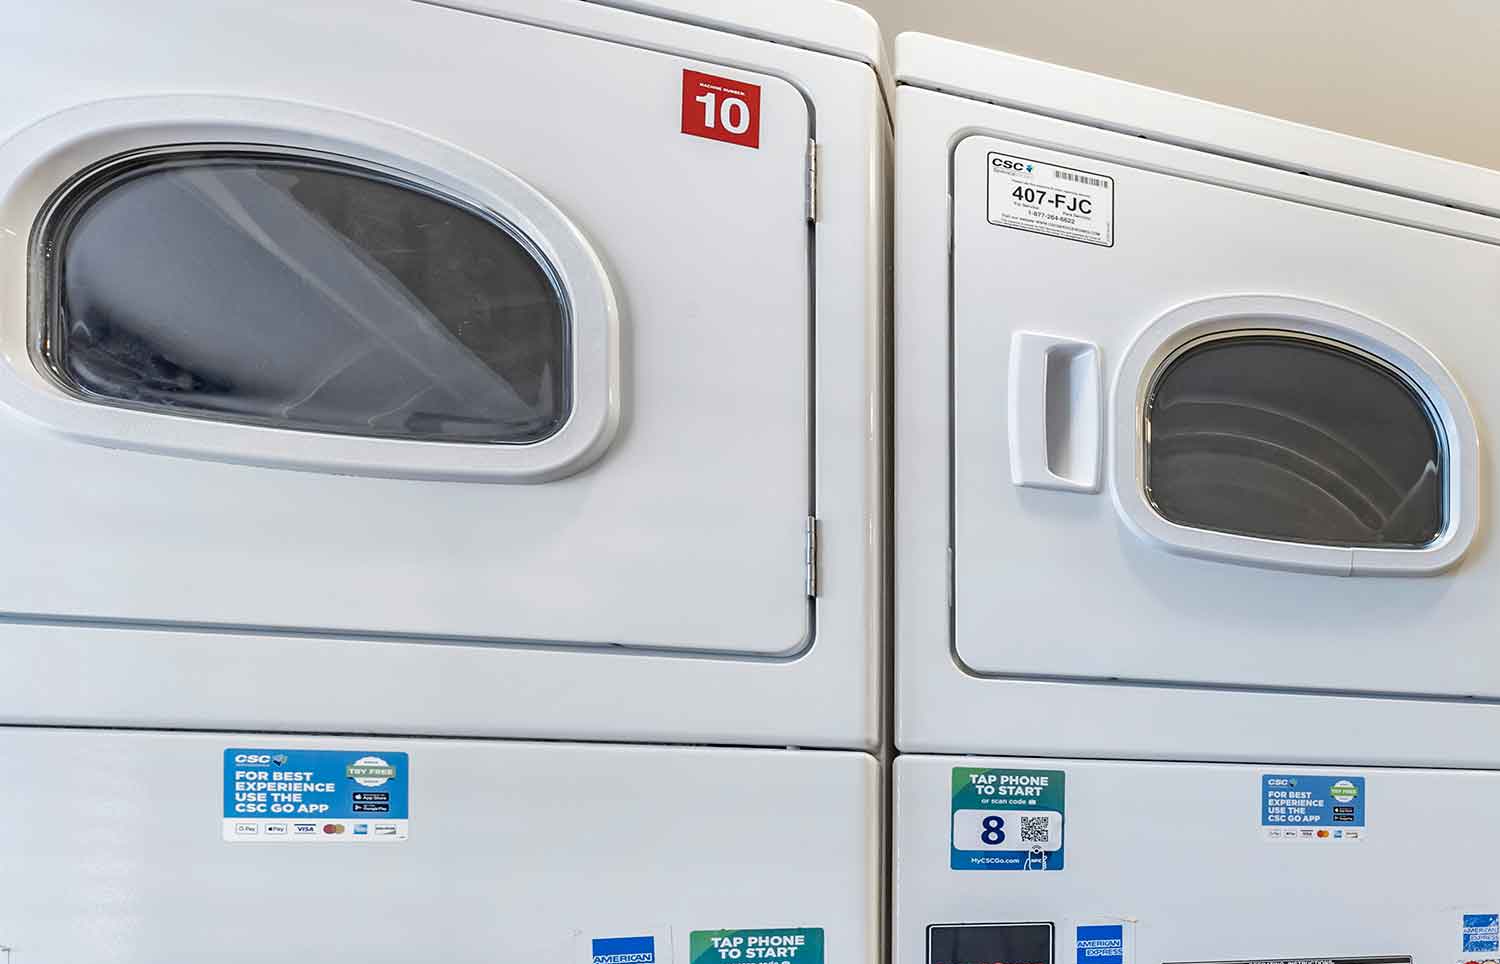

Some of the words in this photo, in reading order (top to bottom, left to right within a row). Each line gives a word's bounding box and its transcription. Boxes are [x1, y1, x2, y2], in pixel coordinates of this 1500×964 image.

[695, 92, 751, 135] 10
[992, 158, 1024, 172] CSC
[1012, 186, 1092, 215] 407-FJC
[235, 754, 271, 765] CSC
[235, 771, 269, 782] FOR
[272, 771, 313, 782] BEST
[969, 774, 997, 785] TAP
[1000, 775, 1049, 787] PHONE
[235, 782, 336, 793] EXPERIENCE
[975, 785, 995, 795] TO
[998, 786, 1043, 797] START
[235, 793, 270, 802] USE
[271, 793, 303, 802] THE
[1268, 791, 1287, 799] FOR
[1288, 791, 1312, 799] BEST
[235, 803, 267, 813] CSC
[270, 803, 295, 813] GO
[298, 803, 329, 814] APP
[1268, 799, 1324, 807] EXPERIENCE
[1287, 807, 1306, 815] THE
[1302, 815, 1321, 823] APP
[980, 815, 1005, 846] 8
[711, 936, 746, 949] TAP
[747, 935, 805, 948] PHONE
[1077, 939, 1120, 948] AMERICAN
[718, 948, 742, 960] TO
[745, 946, 798, 959] START
[1085, 948, 1123, 956] EXPRESS
[593, 953, 652, 964] AMERICAN
